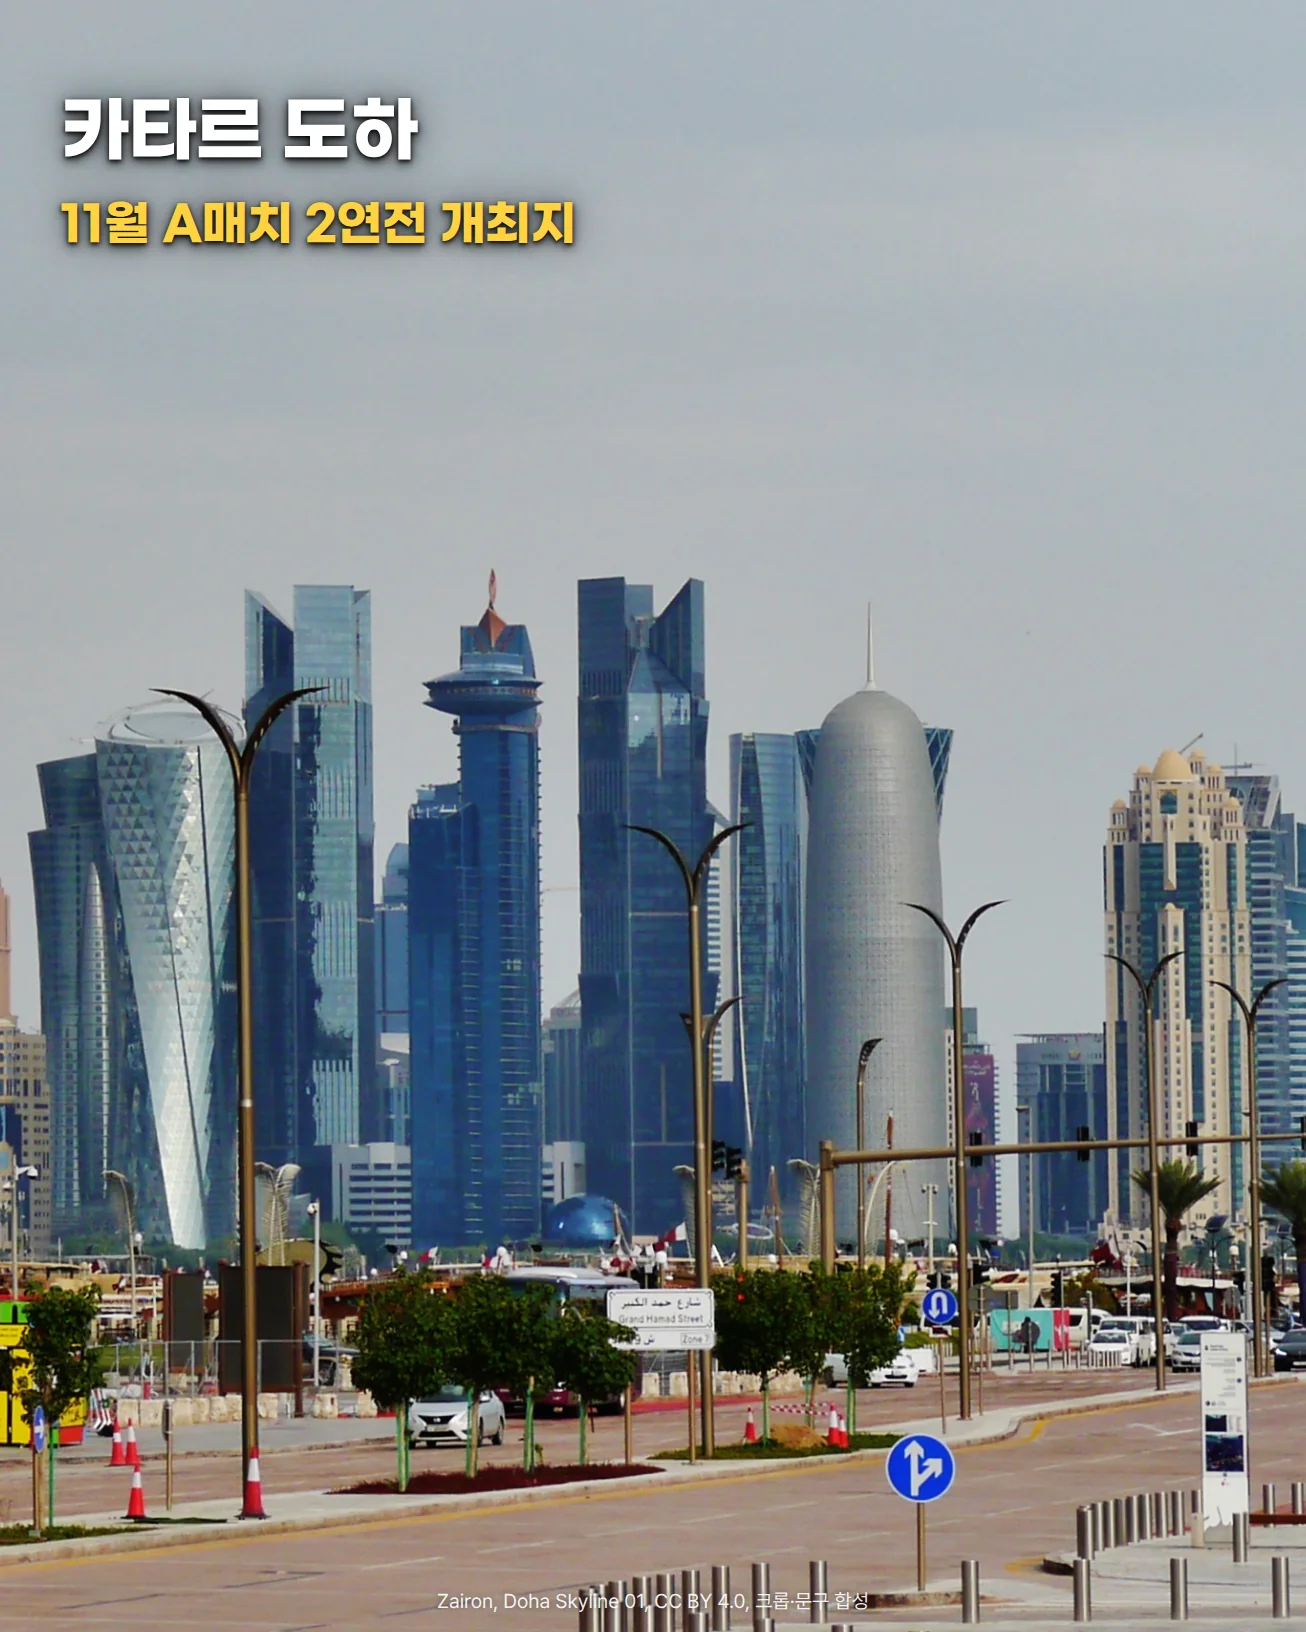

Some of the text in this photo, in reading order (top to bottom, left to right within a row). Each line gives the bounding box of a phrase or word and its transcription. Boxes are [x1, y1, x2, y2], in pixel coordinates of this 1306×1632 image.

[621, 1297, 701, 1310] شارع حمد الكبير
[619, 1314, 704, 1324] Grand Hamad Street
[683, 1334, 703, 1344] Zone
